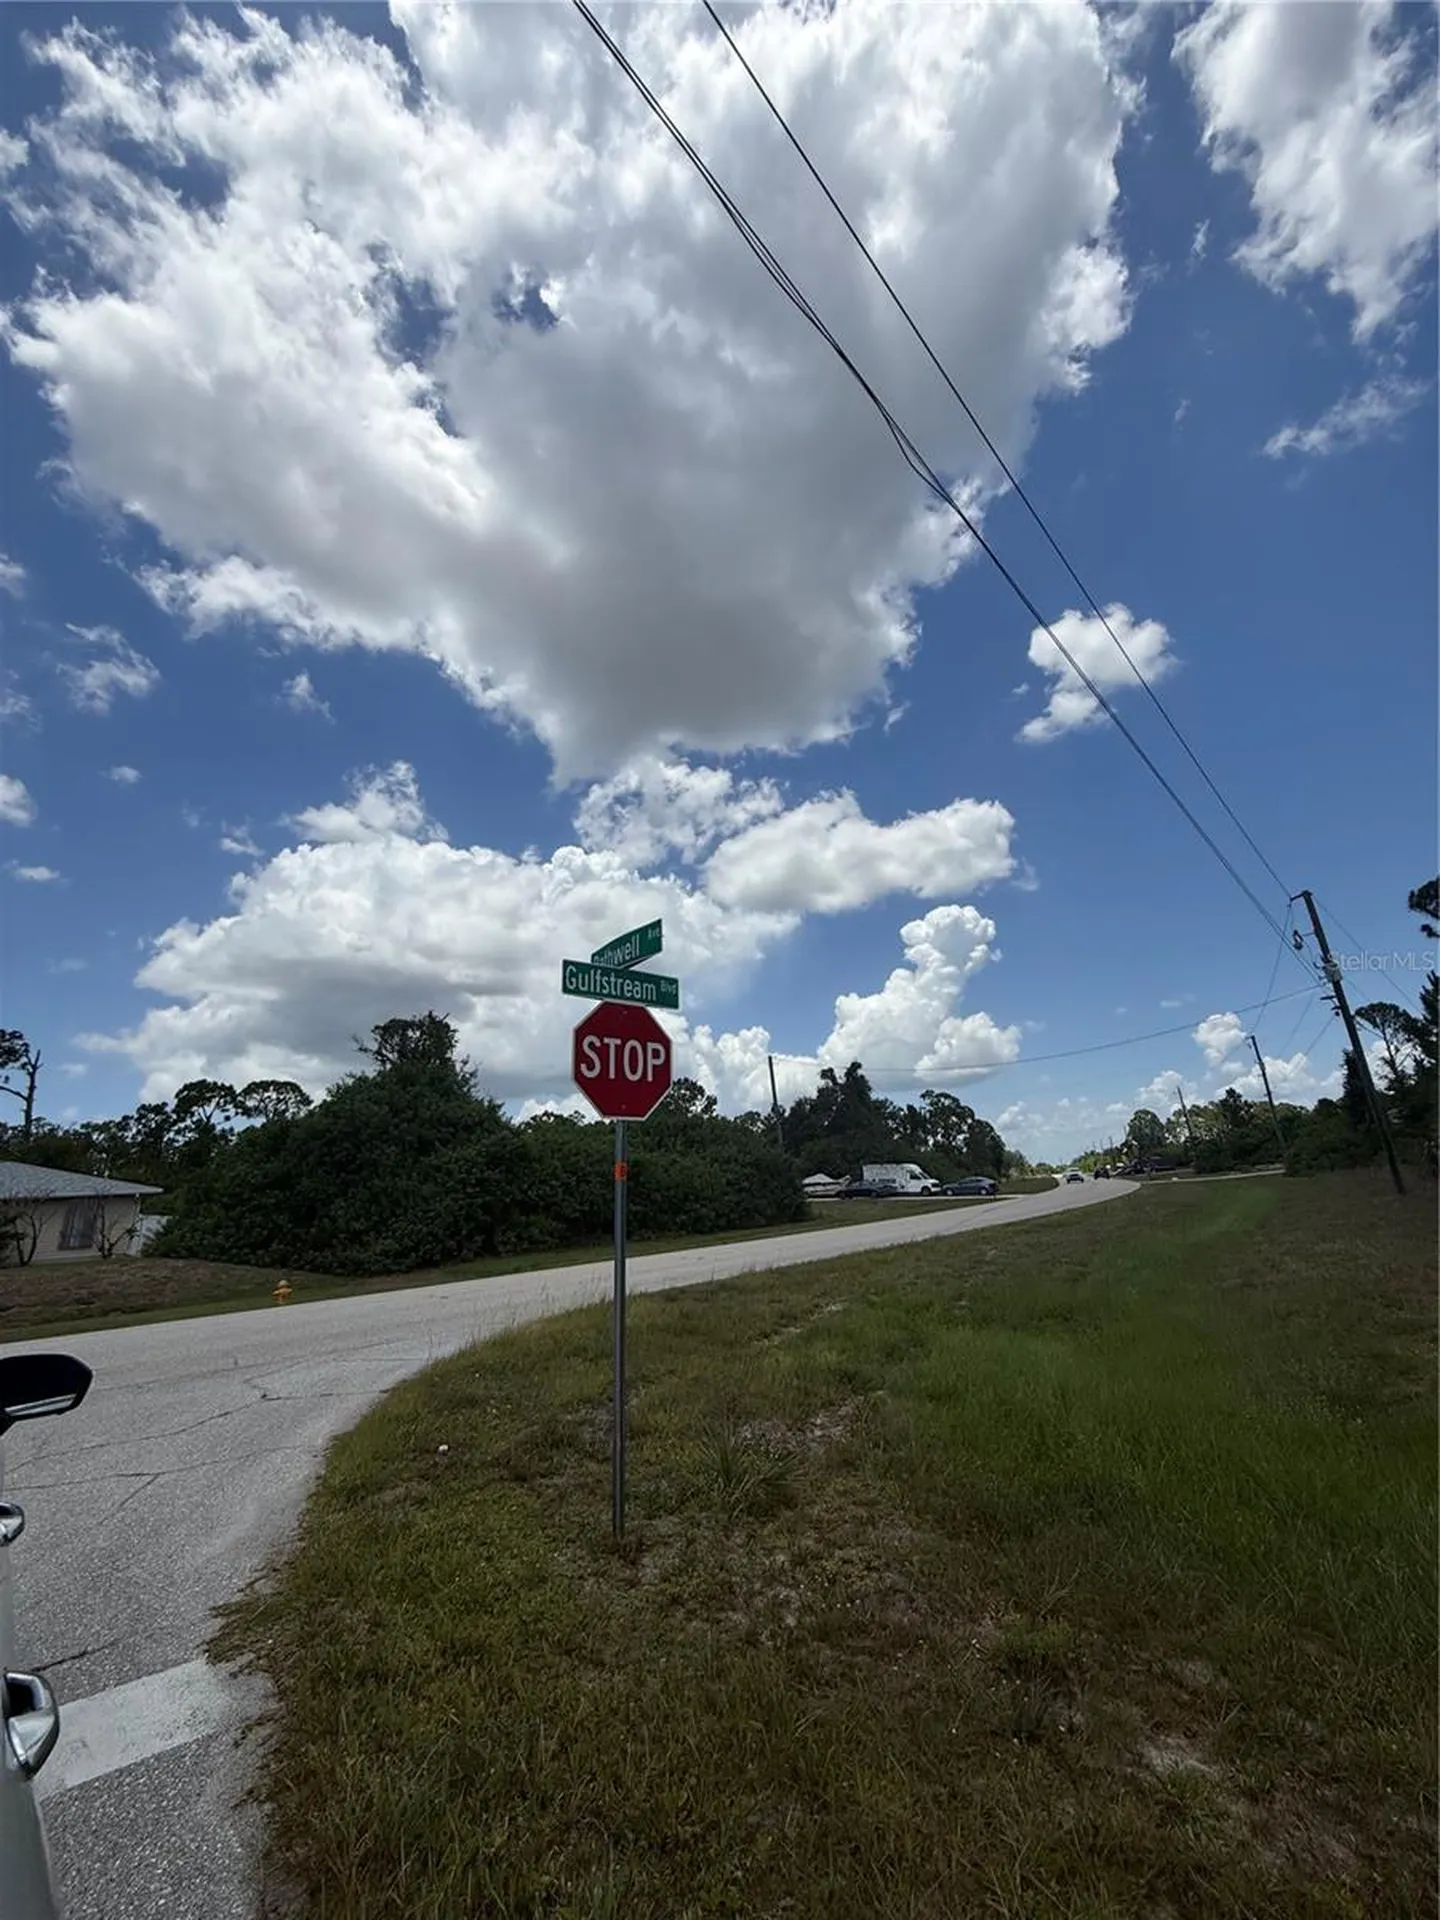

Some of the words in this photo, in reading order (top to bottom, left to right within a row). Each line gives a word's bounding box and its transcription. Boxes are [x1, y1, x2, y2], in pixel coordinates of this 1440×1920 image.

[565, 965, 656, 1001] Gulfstream
[660, 979, 677, 995] Blvd
[580, 1034, 665, 1082] STOP
